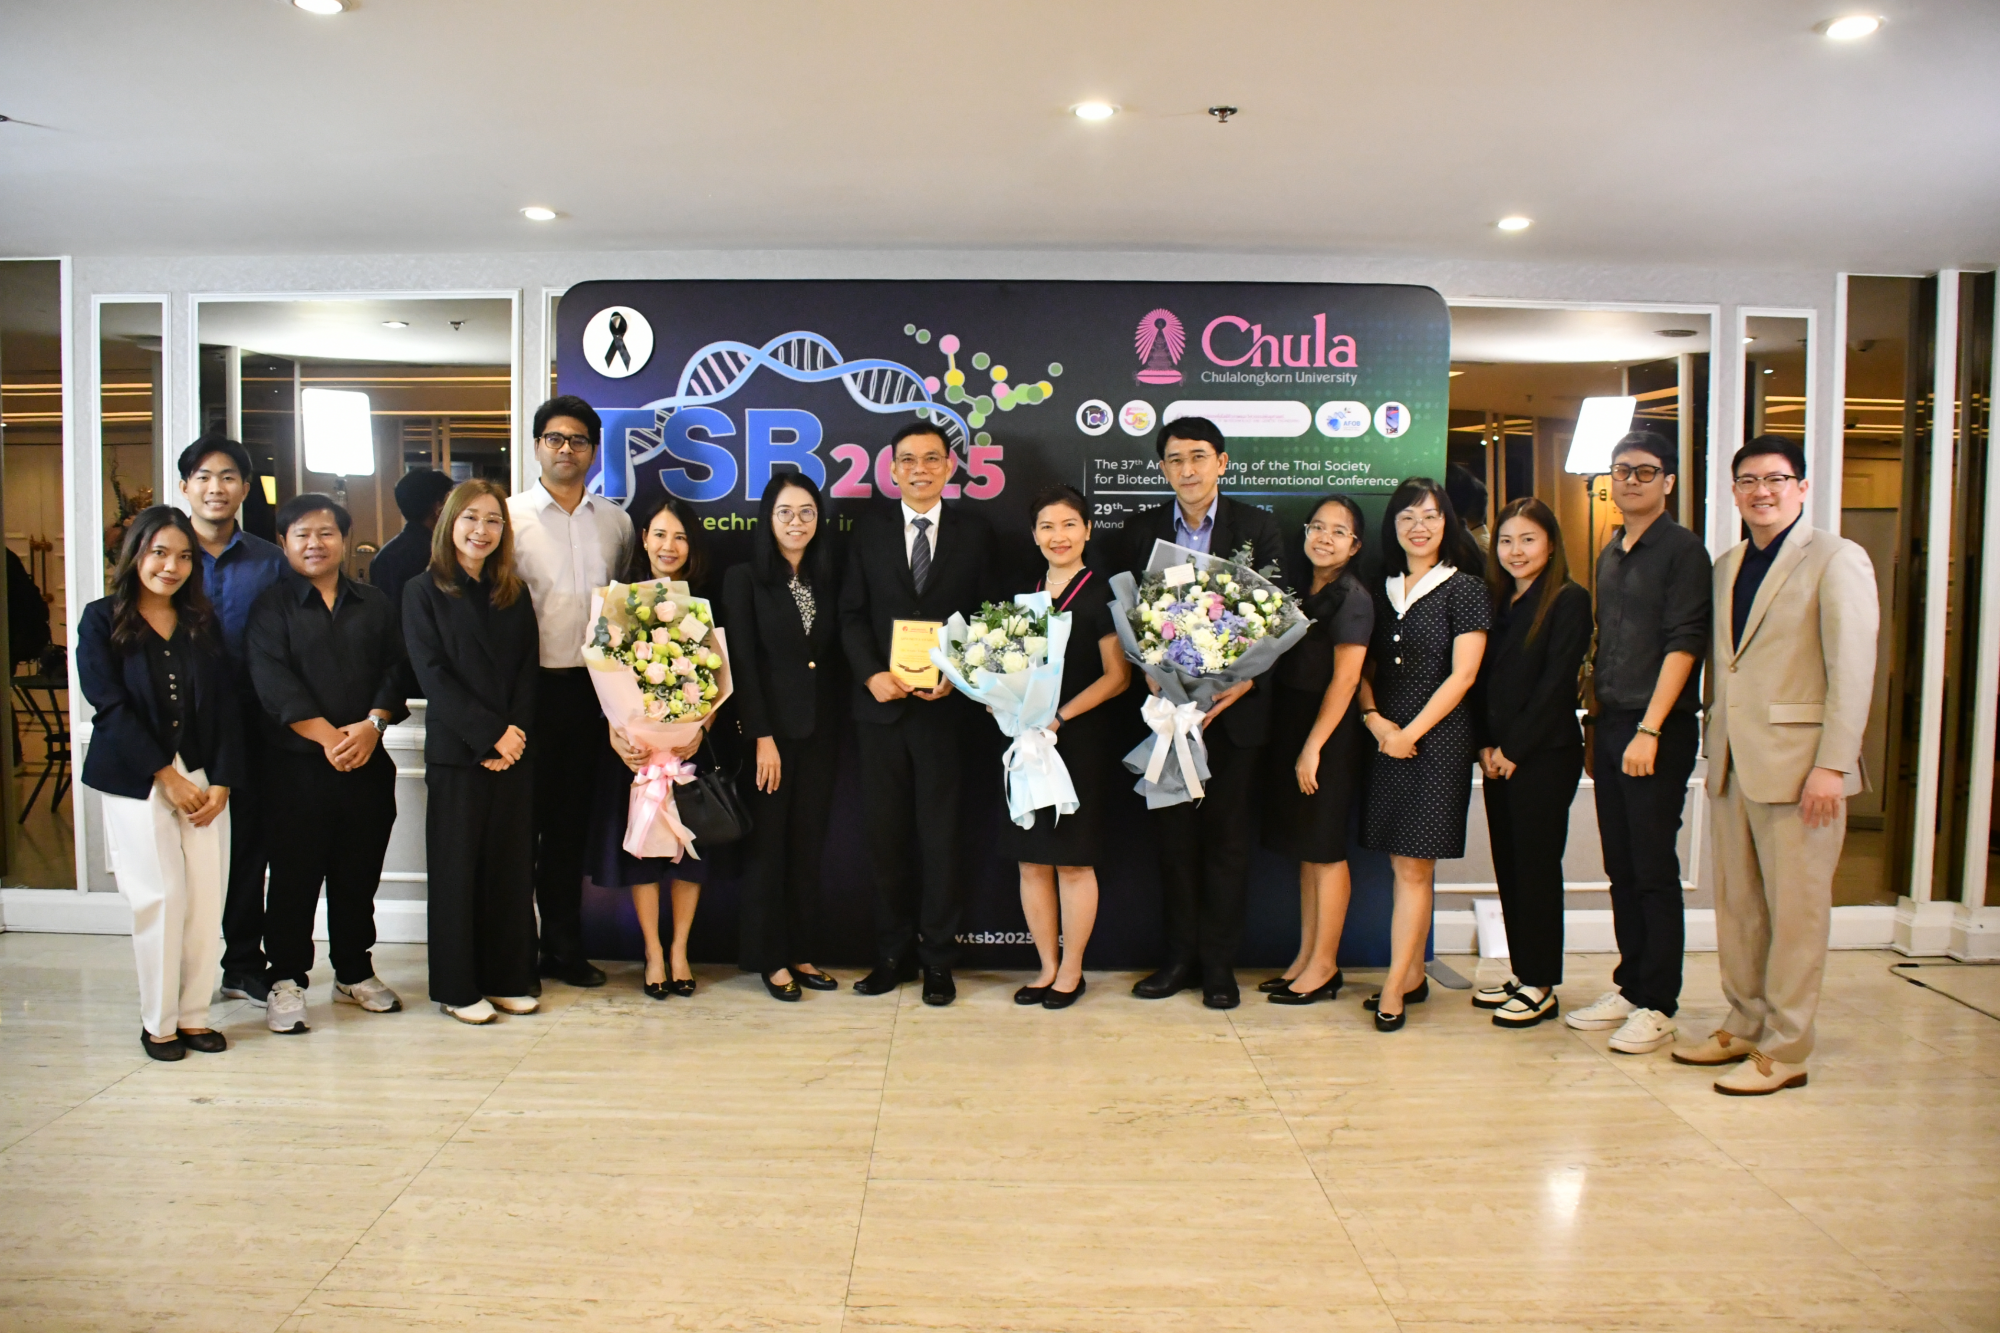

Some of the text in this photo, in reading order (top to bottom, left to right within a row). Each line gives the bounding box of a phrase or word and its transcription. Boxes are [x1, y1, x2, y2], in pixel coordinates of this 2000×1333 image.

[1201, 312, 1358, 368] Chula
[1201, 371, 1358, 386] Chulalongkorn University
[1094, 459, 1118, 470] The
[1121, 459, 1143, 470] 37th
[1251, 460, 1266, 471] of
[1268, 460, 1290, 471] the
[1293, 460, 1321, 472] Thai
[1324, 461, 1371, 474] Society
[1094, 474, 1114, 485] for
[1117, 474, 1170, 485] Biotech
[1240, 475, 1324, 486] International
[1327, 475, 1399, 487] Conference
[1094, 520, 1125, 529] Mand
